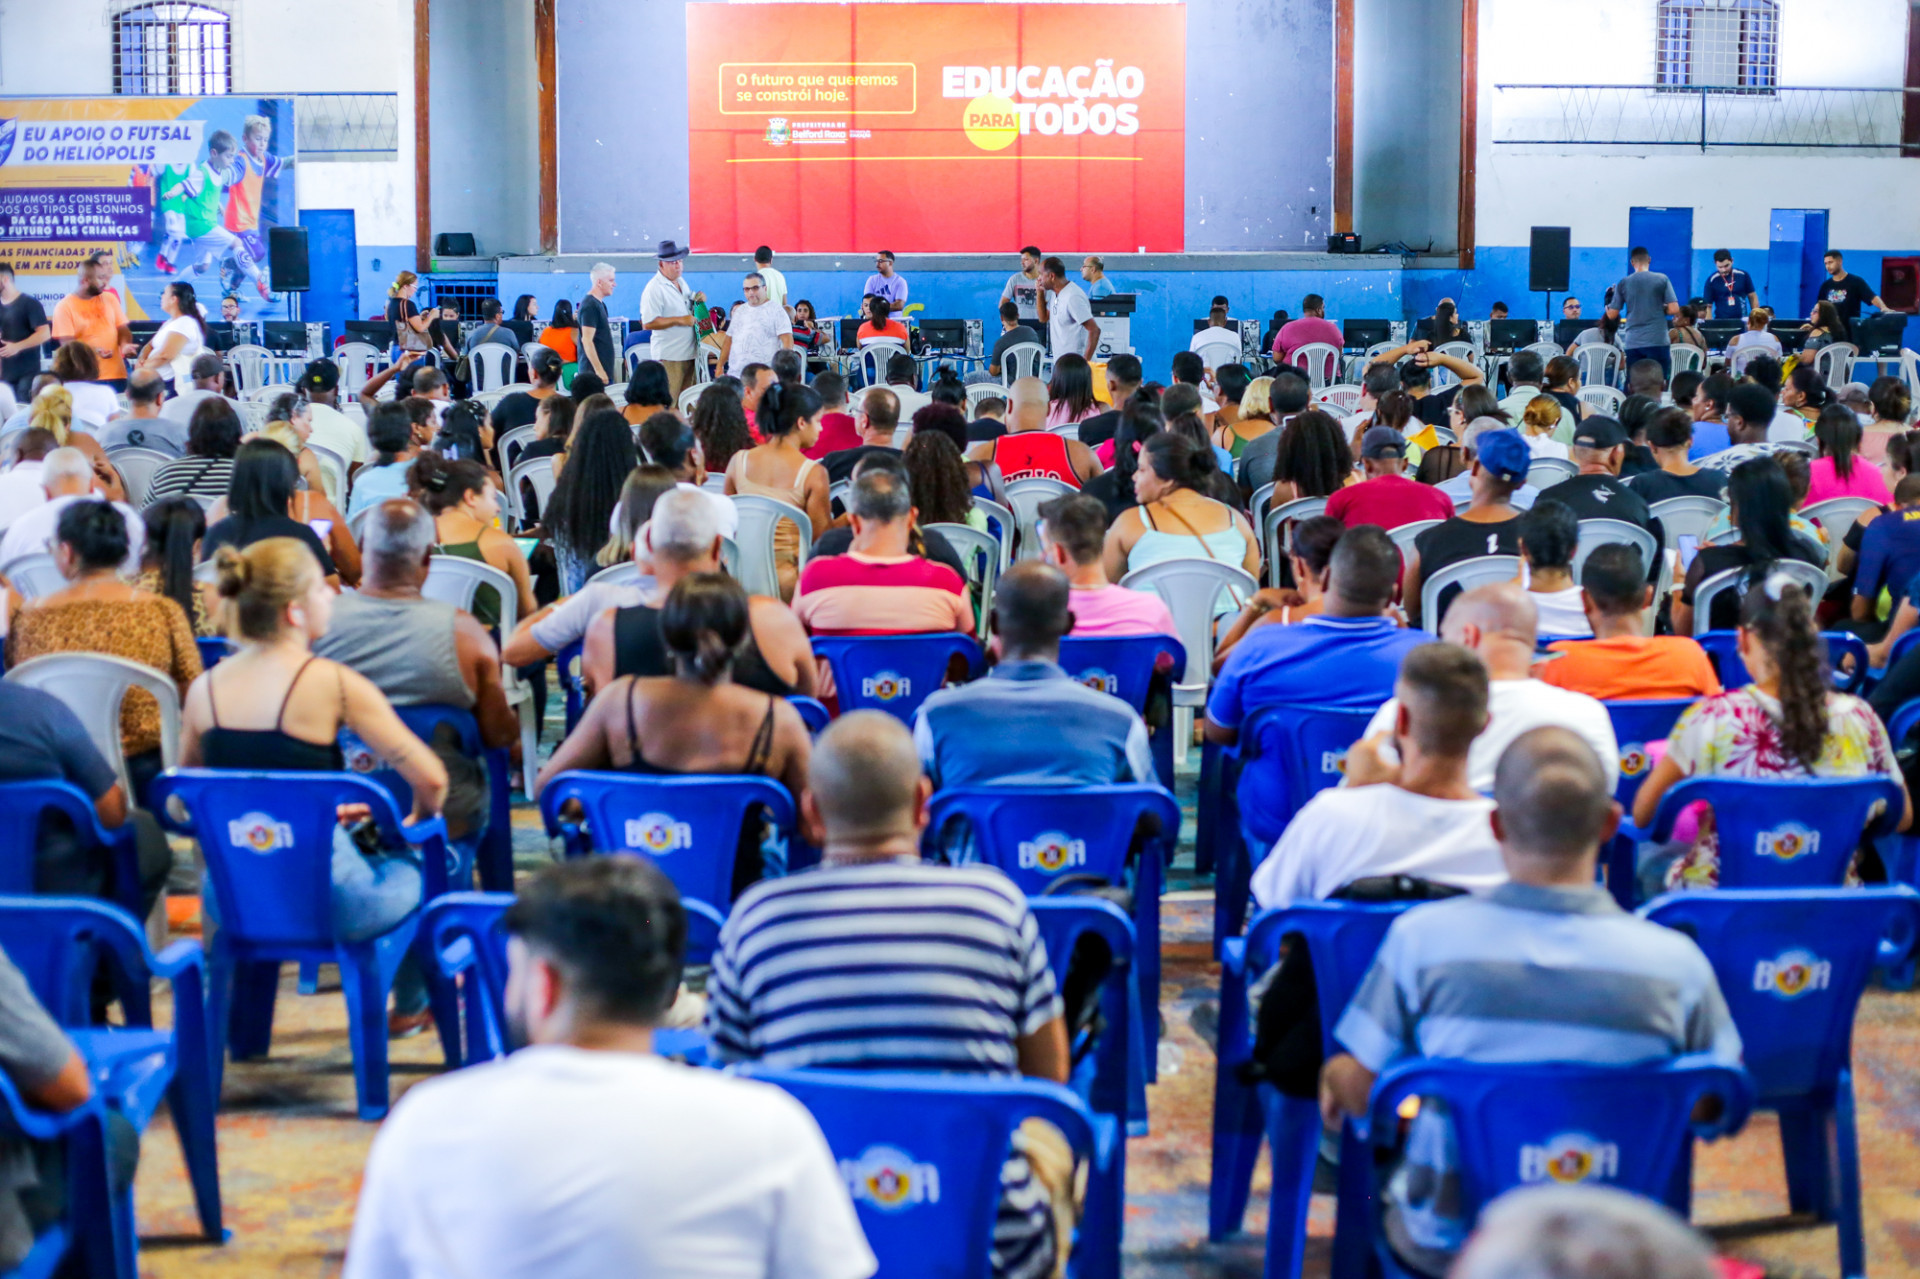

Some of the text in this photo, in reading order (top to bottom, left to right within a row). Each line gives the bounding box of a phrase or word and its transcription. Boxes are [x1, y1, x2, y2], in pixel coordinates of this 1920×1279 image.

[736, 73, 899, 88] O futuro que queremos
[942, 58, 1145, 105] EDUCAÇÃO
[736, 88, 849, 103] se constrói hoje.
[969, 113, 1015, 128] PARA
[1012, 102, 1140, 135] TODOS
[23, 126, 192, 142] EU APOIO O FUTSAL
[792, 130, 847, 139] Belford Roxo
[23, 142, 156, 161] DO HELIÓPOLIS
[58, 194, 65, 204] A
[68, 194, 132, 204] CONSTRUIR
[23, 205, 39, 214] OS
[42, 205, 74, 214] TIPOS
[79, 205, 92, 214] DE
[95, 204, 144, 214] SONHOS
[11, 213, 116, 225] DA CASA PRÓPRIA,
[9, 226, 52, 235] FUTURO
[56, 226, 78, 235] DAS
[81, 226, 139, 237] CRIANÇAS
[16, 248, 85, 256] FINANCIADAS
[15, 261, 31, 270] EM
[33, 259, 52, 270] ATÉ
